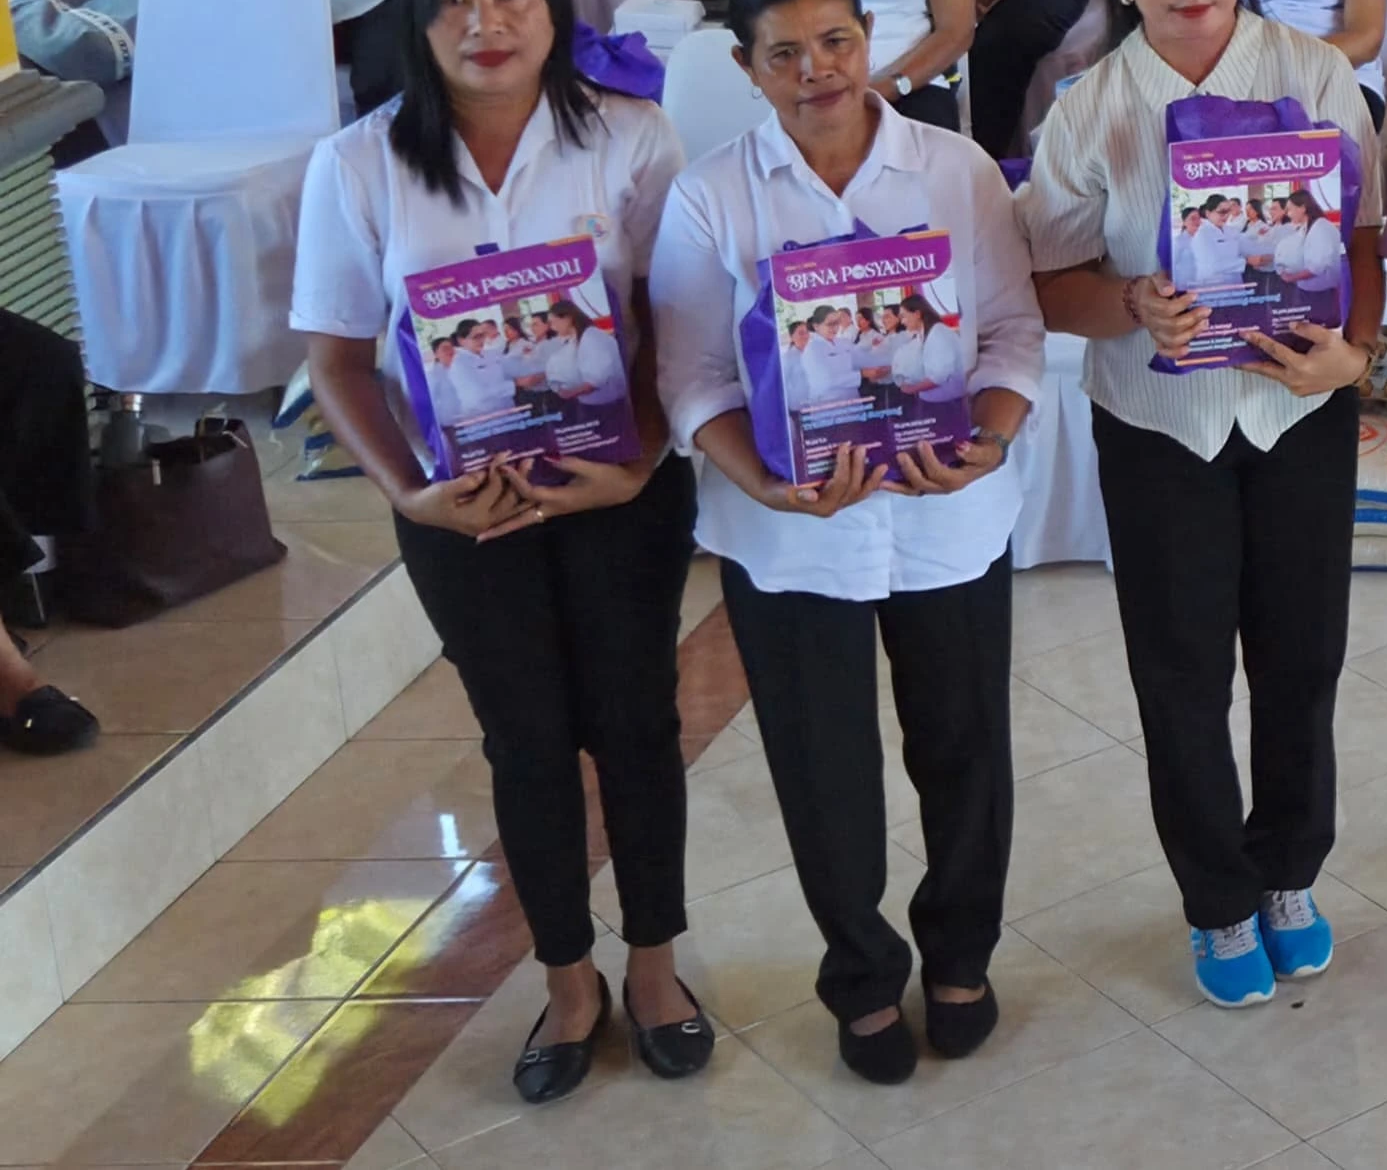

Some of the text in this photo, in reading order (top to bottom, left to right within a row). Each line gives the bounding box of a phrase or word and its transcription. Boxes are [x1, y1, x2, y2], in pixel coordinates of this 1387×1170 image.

[1183, 158, 1233, 180] BINA
[1236, 152, 1324, 175] POSYANDU
[422, 282, 479, 309] BINA
[481, 258, 581, 294] POSYANDU
[786, 269, 838, 293] BINA
[842, 253, 936, 282] POSYANDU
